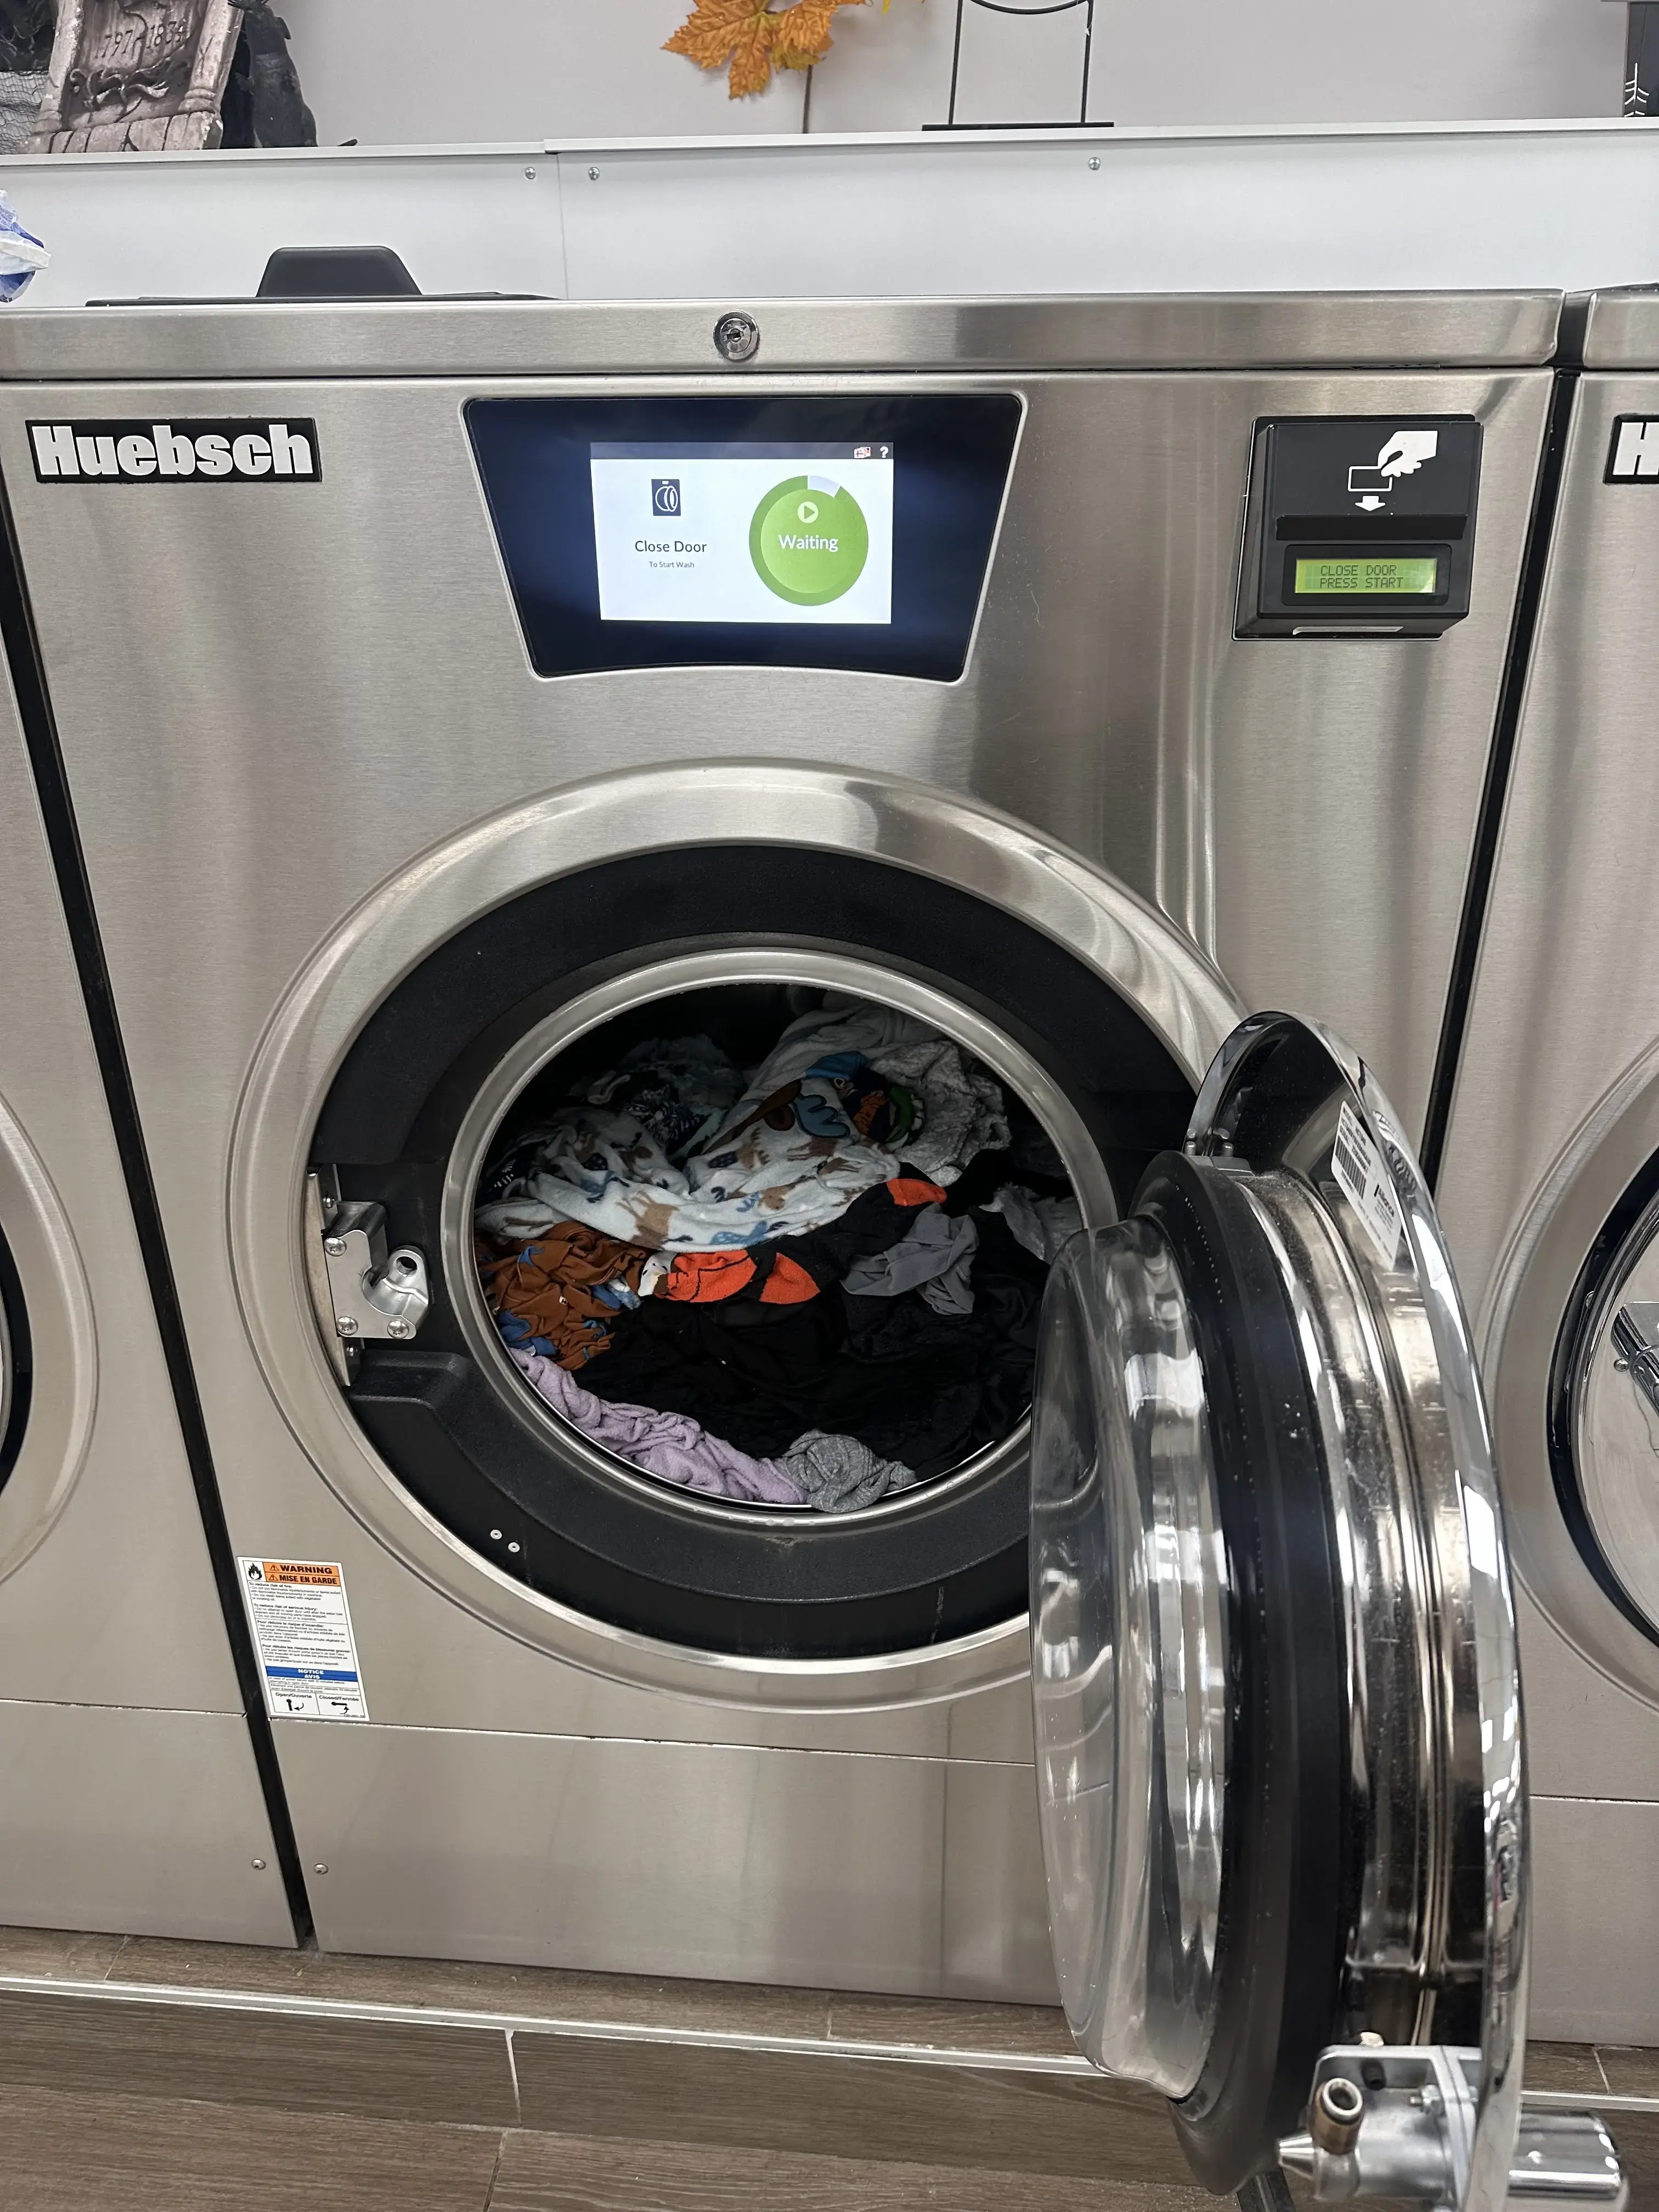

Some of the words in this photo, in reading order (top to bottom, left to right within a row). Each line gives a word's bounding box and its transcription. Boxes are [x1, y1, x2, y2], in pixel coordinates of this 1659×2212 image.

[31, 424, 314, 476] Huebsch
[635, 540, 670, 552] Close
[674, 541, 707, 552] Door
[778, 534, 839, 552] Waiting
[1321, 565, 1359, 576] CLOSE
[1366, 565, 1397, 576] DOOR
[1320, 577, 1358, 588] PRESS
[1365, 577, 1404, 588] START
[280, 1565, 332, 1574] WARNING
